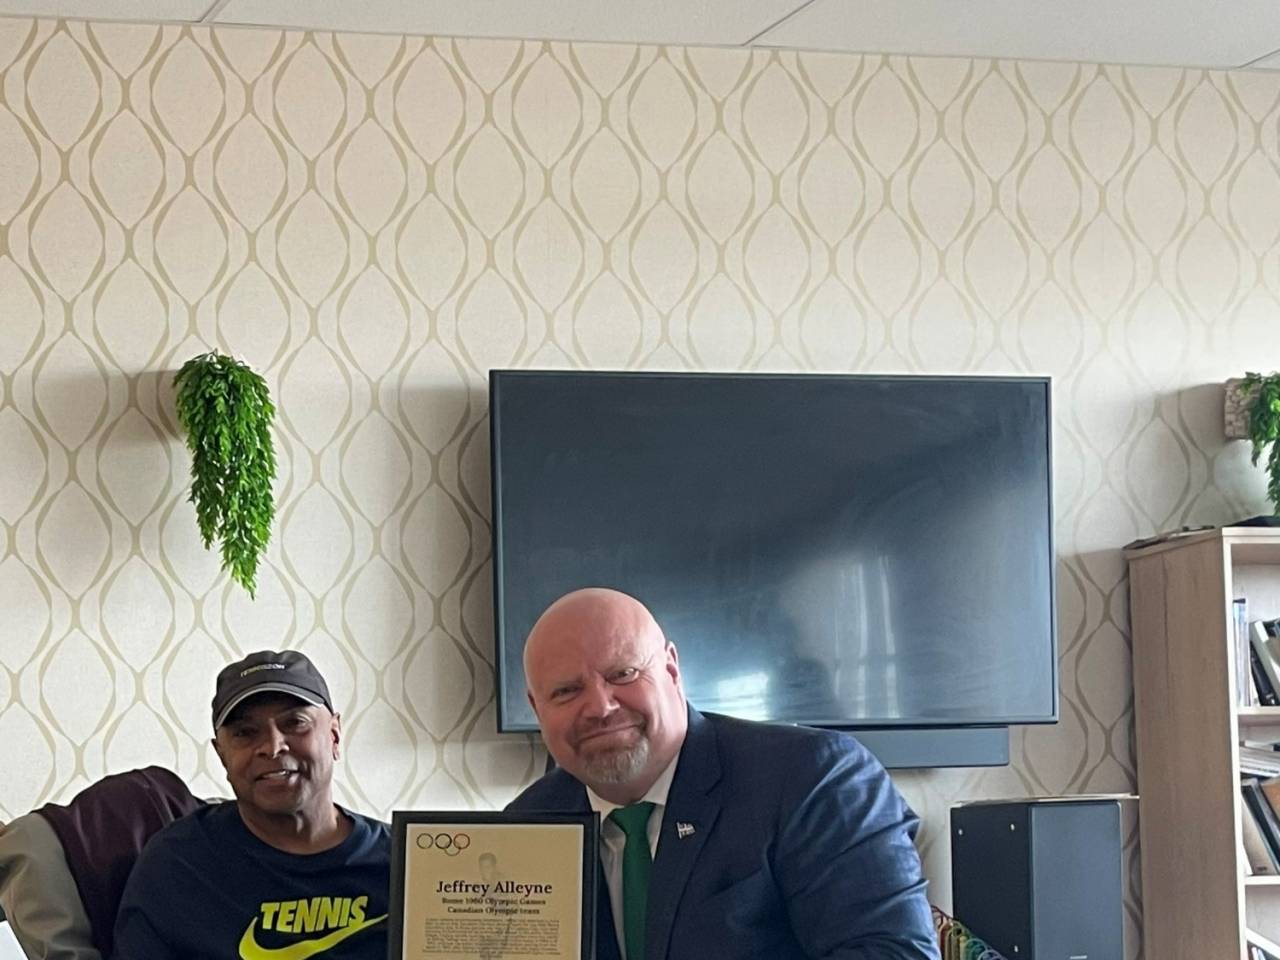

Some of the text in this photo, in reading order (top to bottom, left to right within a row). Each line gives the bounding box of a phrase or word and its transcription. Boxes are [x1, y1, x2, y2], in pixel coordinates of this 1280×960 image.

[436, 880, 553, 897] Jeffrey Alleyne
[260, 895, 369, 934] TENNIS
